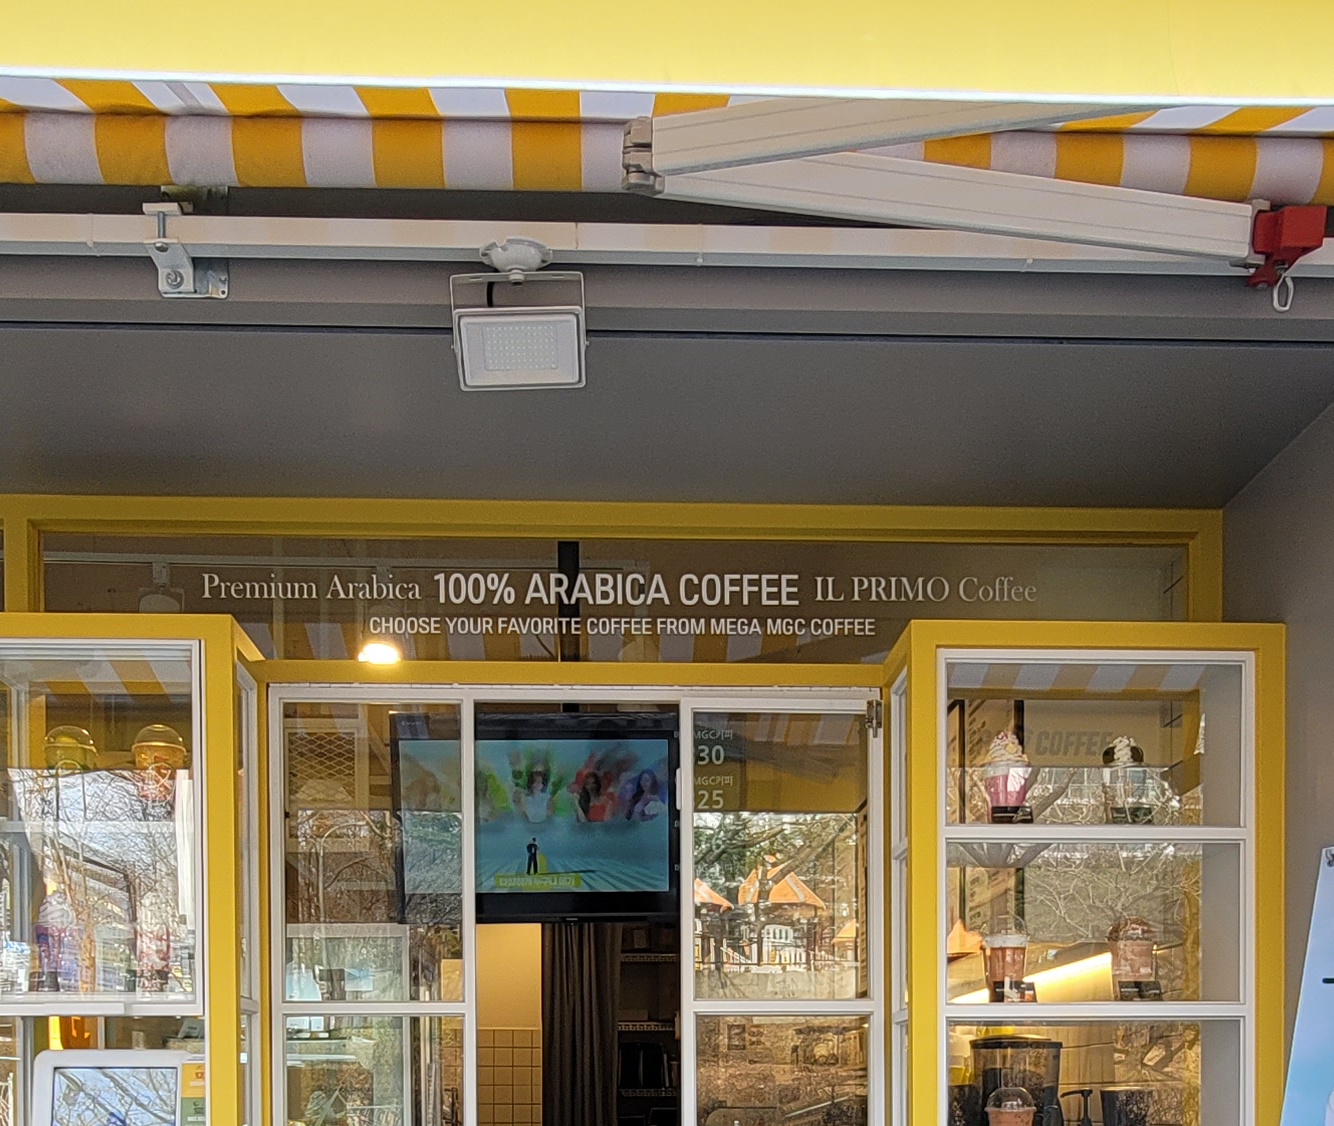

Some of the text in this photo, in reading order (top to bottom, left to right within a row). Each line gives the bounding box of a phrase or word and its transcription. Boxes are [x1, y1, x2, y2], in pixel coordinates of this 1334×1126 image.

[202, 573, 1038, 606] Premium Arabica 100% ARABICA COFFEE IL PRIMO Coffee
[369, 617, 876, 636] CHOOSE YOUR FAVORITE COFFEE FROM MEGA MGC COFFEE
[697, 745, 725, 765] 30
[697, 790, 724, 809] 25
